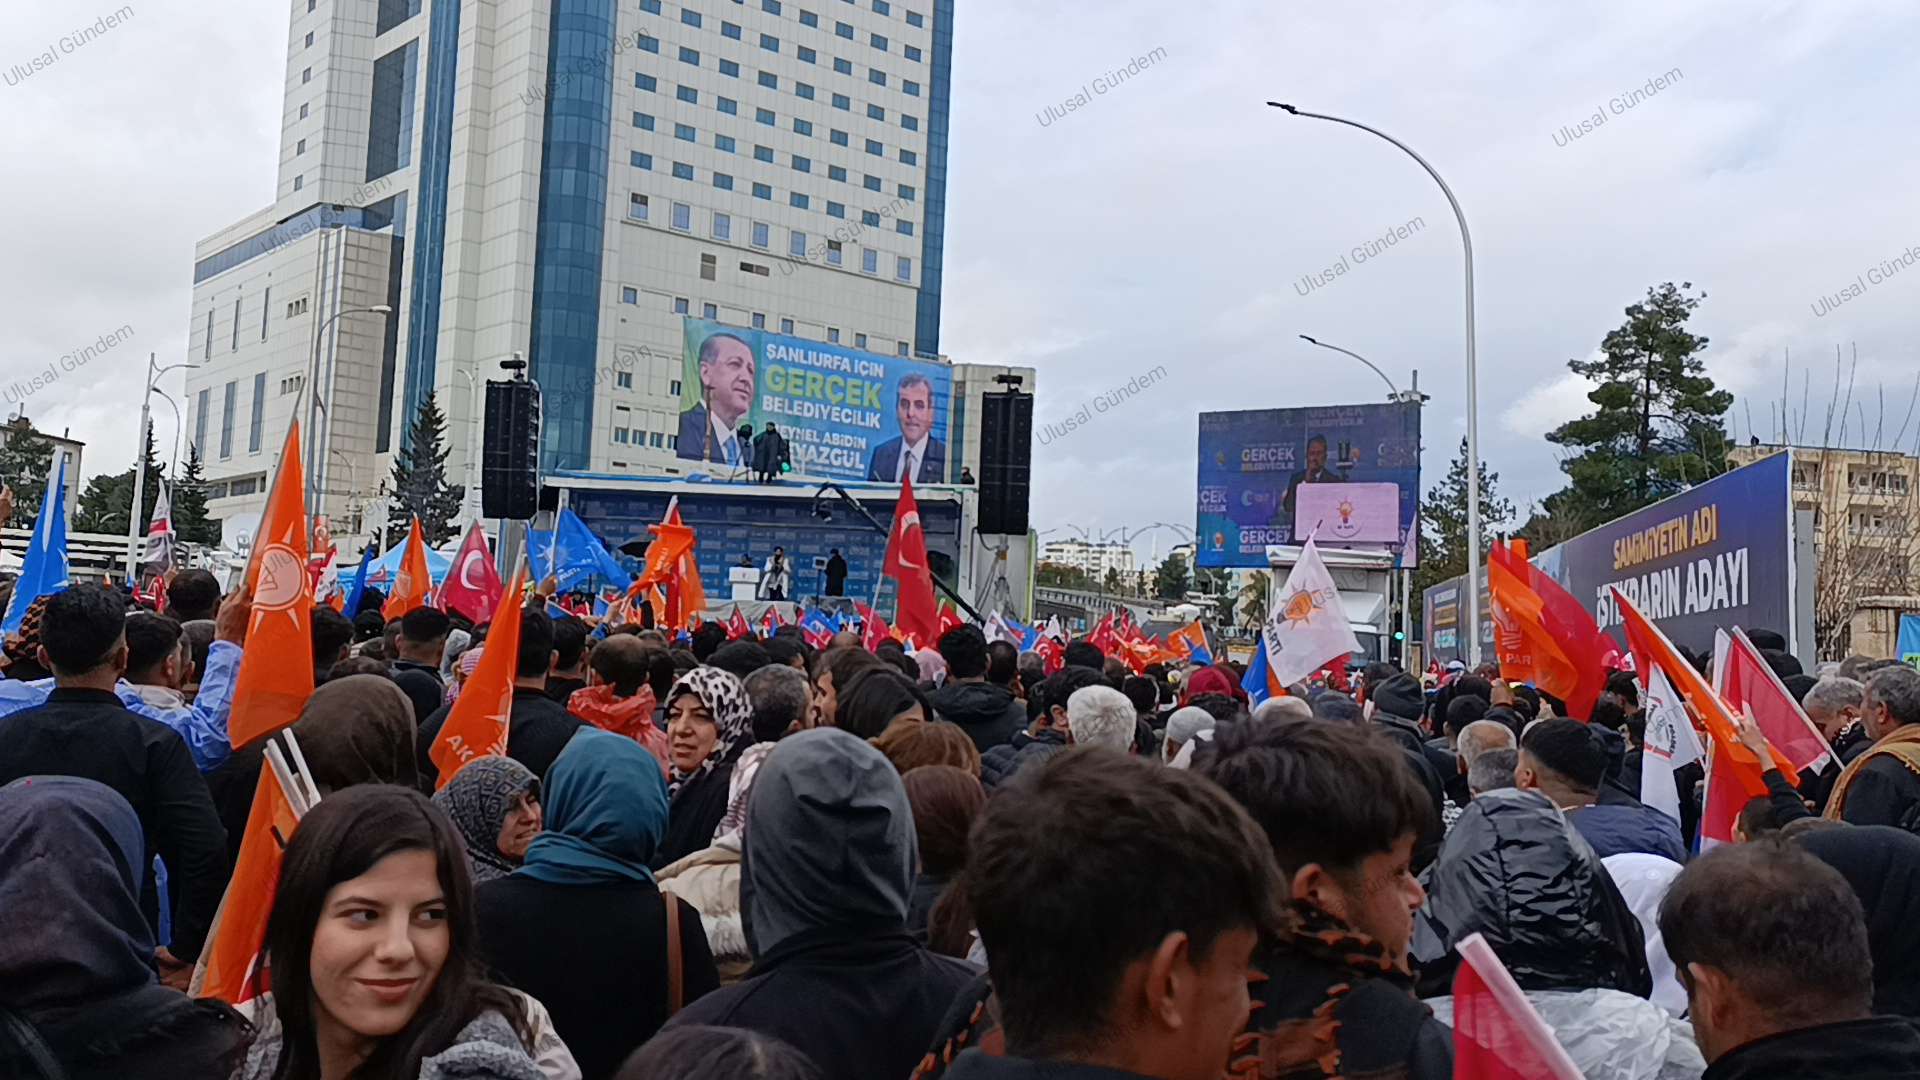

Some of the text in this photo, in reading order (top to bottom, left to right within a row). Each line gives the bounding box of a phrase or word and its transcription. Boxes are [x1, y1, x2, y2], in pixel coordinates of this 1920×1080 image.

[765, 364, 882, 408] GERÇEK
[1691, 504, 1717, 546] ADI
[1684, 548, 1749, 615] ADAYI
[445, 735, 474, 762] AK
